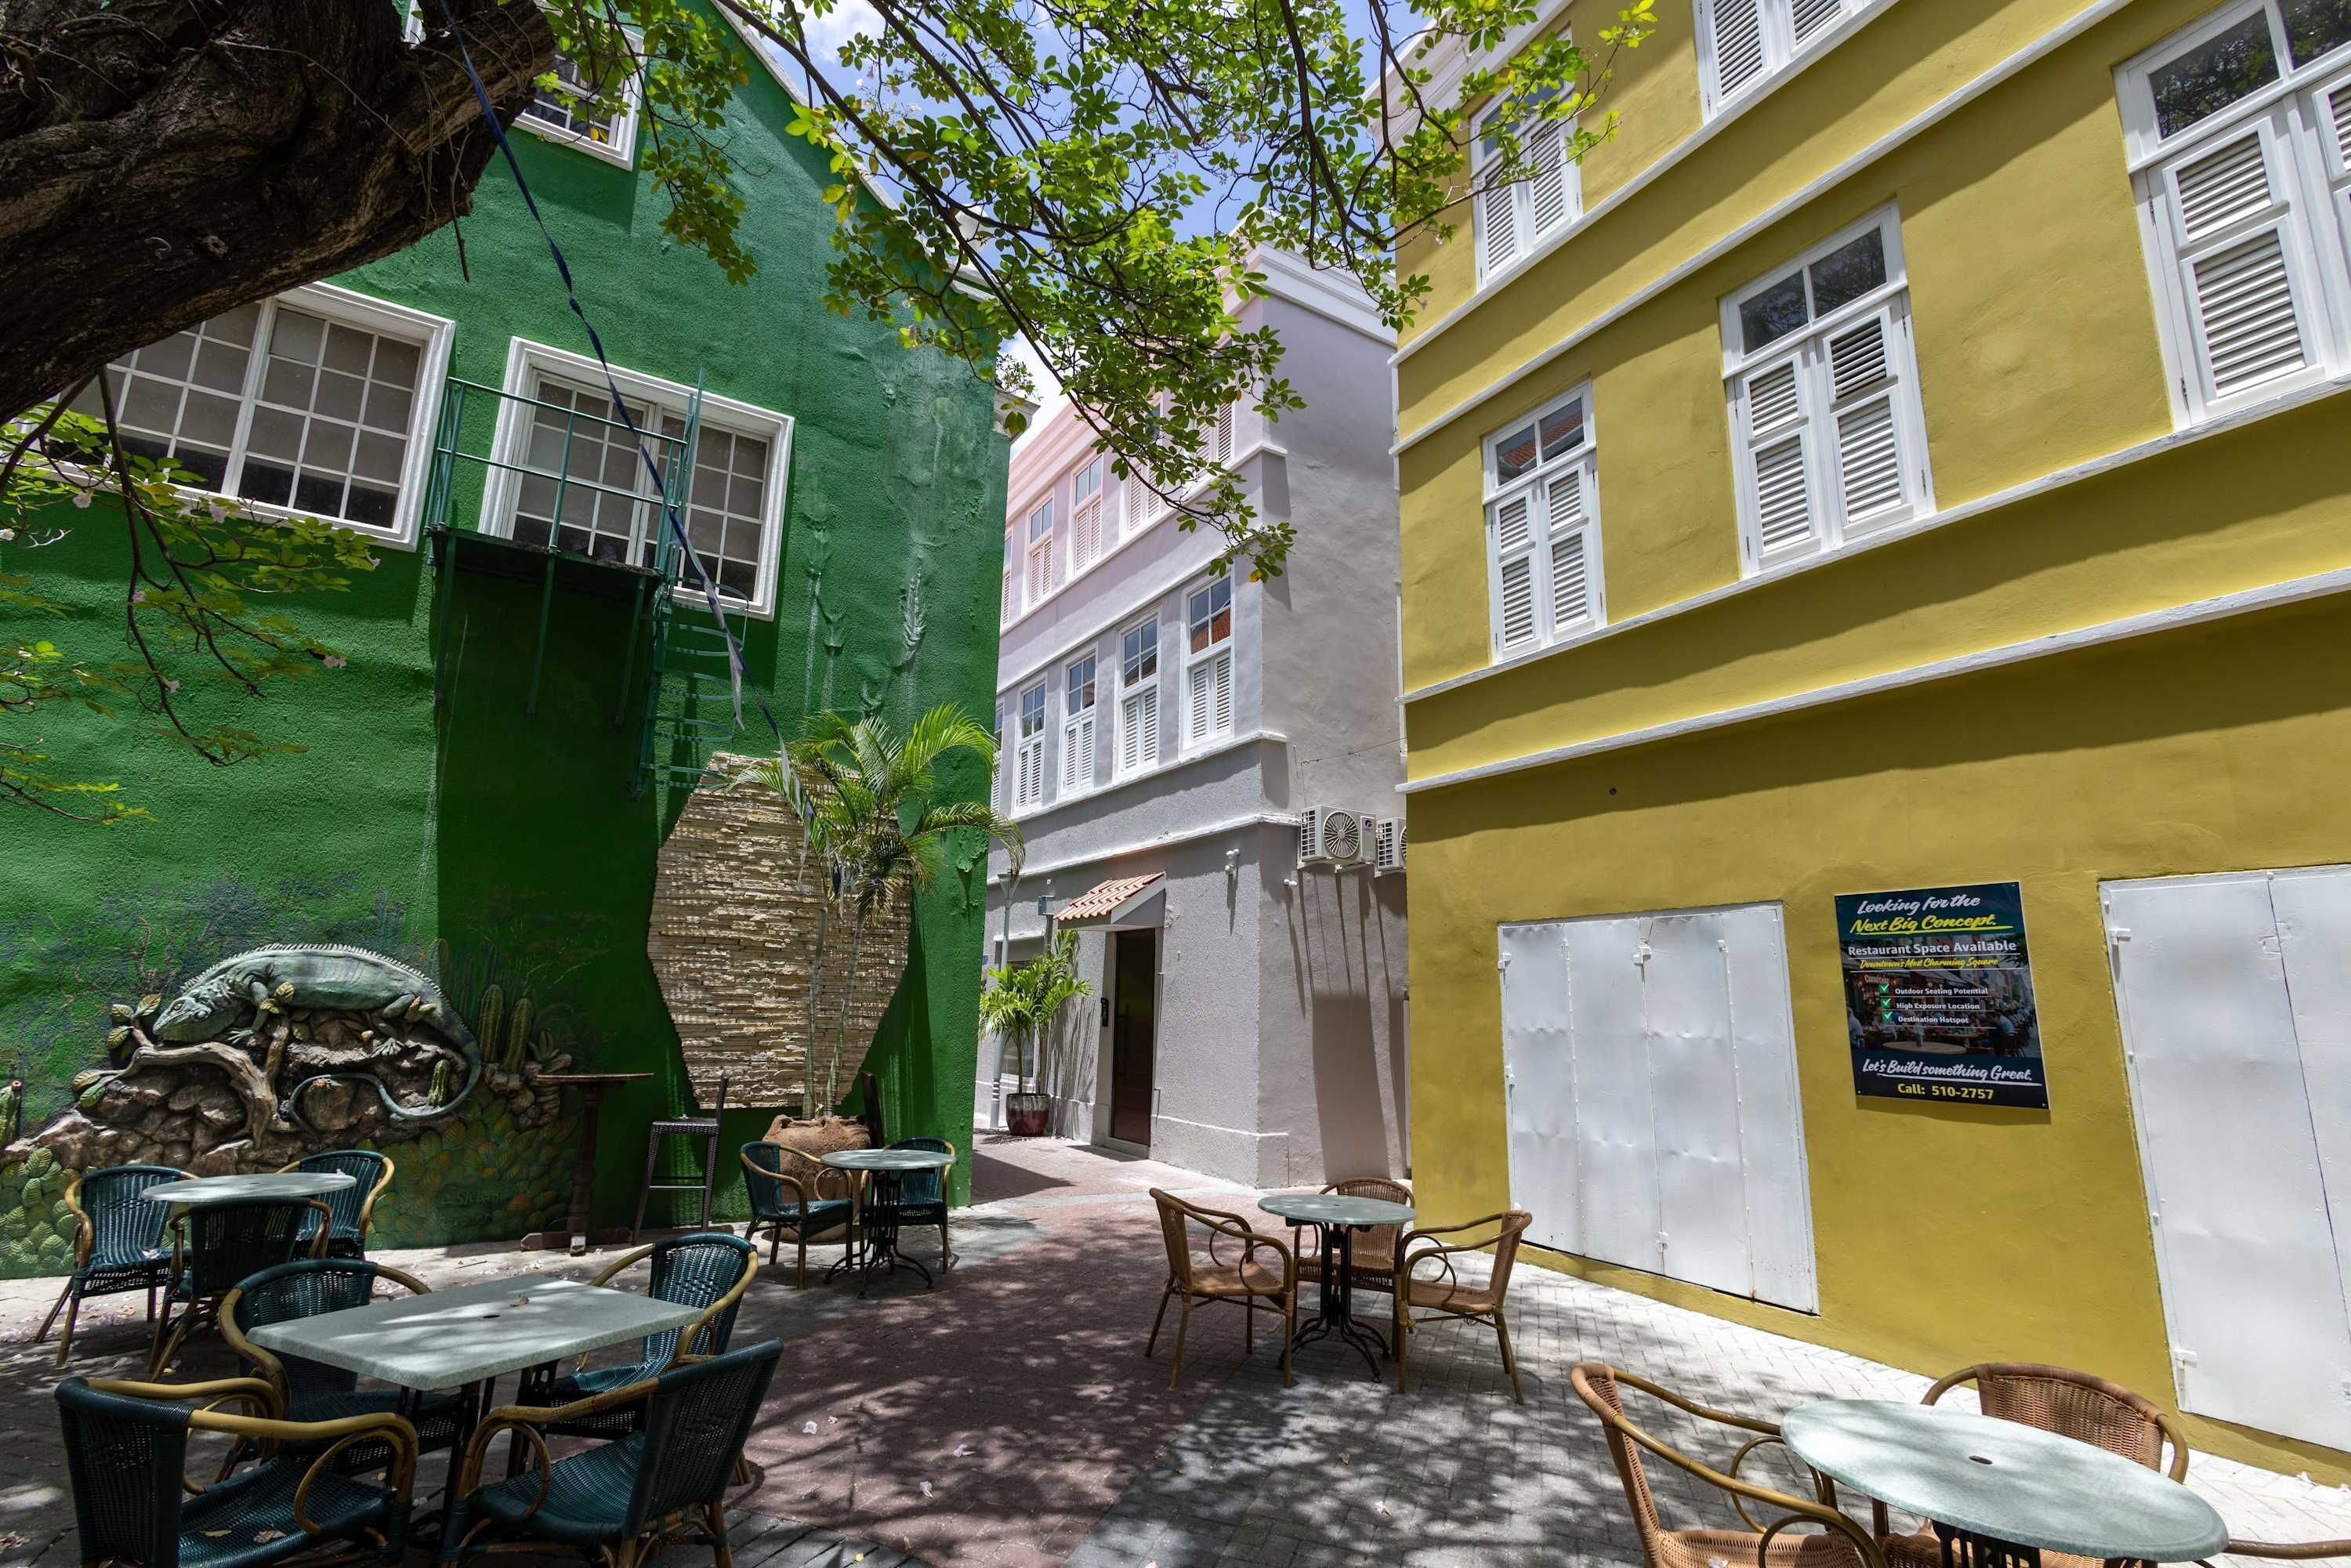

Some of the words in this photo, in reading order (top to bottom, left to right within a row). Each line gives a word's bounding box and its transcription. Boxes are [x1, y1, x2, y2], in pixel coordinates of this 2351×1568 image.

[1857, 899, 1921, 916] Looking
[1949, 894, 1981, 907] the
[1849, 918, 1889, 933] Next
[1889, 917, 1918, 932] Big
[1922, 914, 1997, 930] Concept.
[1848, 946, 1911, 955] Restaurant
[1913, 943, 1950, 955] Space
[1954, 940, 2017, 952] Available
[1923, 958, 1965, 969] Charming
[1966, 957, 1999, 969] Square
[1925, 987, 1953, 996] Seating
[1914, 1002, 1947, 1011] Exposure
[1940, 1016, 1969, 1025] Hotspot
[1862, 1059, 1886, 1073] Let's
[1886, 1059, 1923, 1075] Build
[1921, 1063, 1988, 1081] something
[1991, 1065, 2032, 1081] Great.
[1897, 1083, 1925, 1095] Call:
[1931, 1085, 1994, 1099] 510-2757
